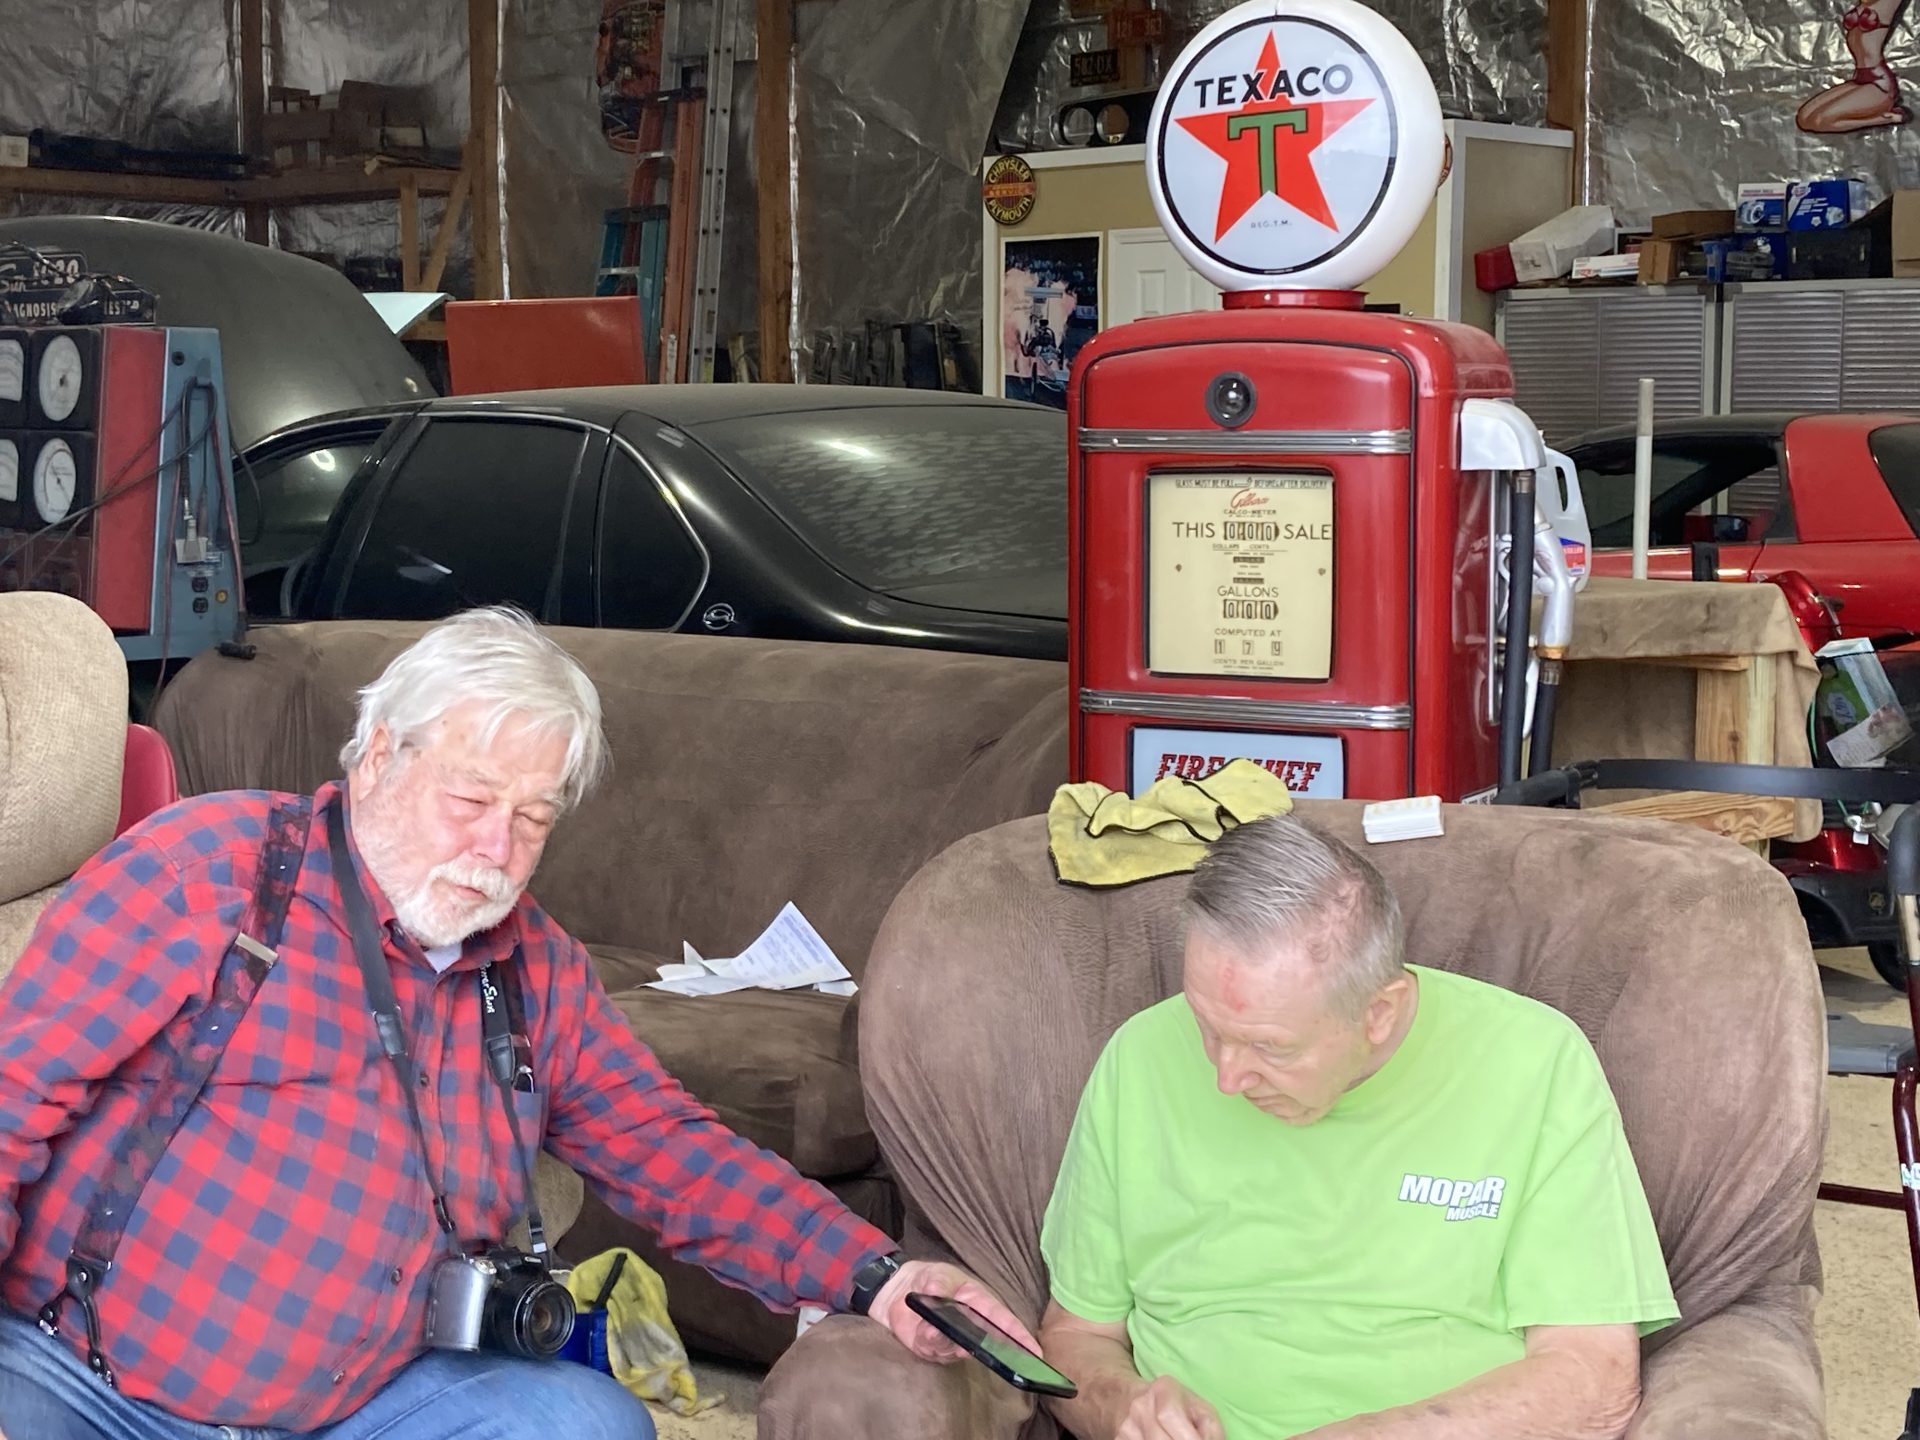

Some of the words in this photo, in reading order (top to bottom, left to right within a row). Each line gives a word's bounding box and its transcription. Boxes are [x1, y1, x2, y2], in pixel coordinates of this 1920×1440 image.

[1194, 64, 1353, 108] TEXACO
[1227, 107, 1309, 196] T
[988, 160, 1030, 183] CHRYSLER
[988, 197, 1031, 220] PLYMOUTH
[1172, 521, 1216, 538] THIS
[1283, 524, 1332, 540] SALE
[1217, 585, 1279, 598] GALLONS
[1214, 628, 1266, 637] COMPUTED
[1269, 629, 1282, 637] AT
[1398, 1173, 1506, 1208] MOPAR
[1445, 1202, 1499, 1222] MUSCLE
